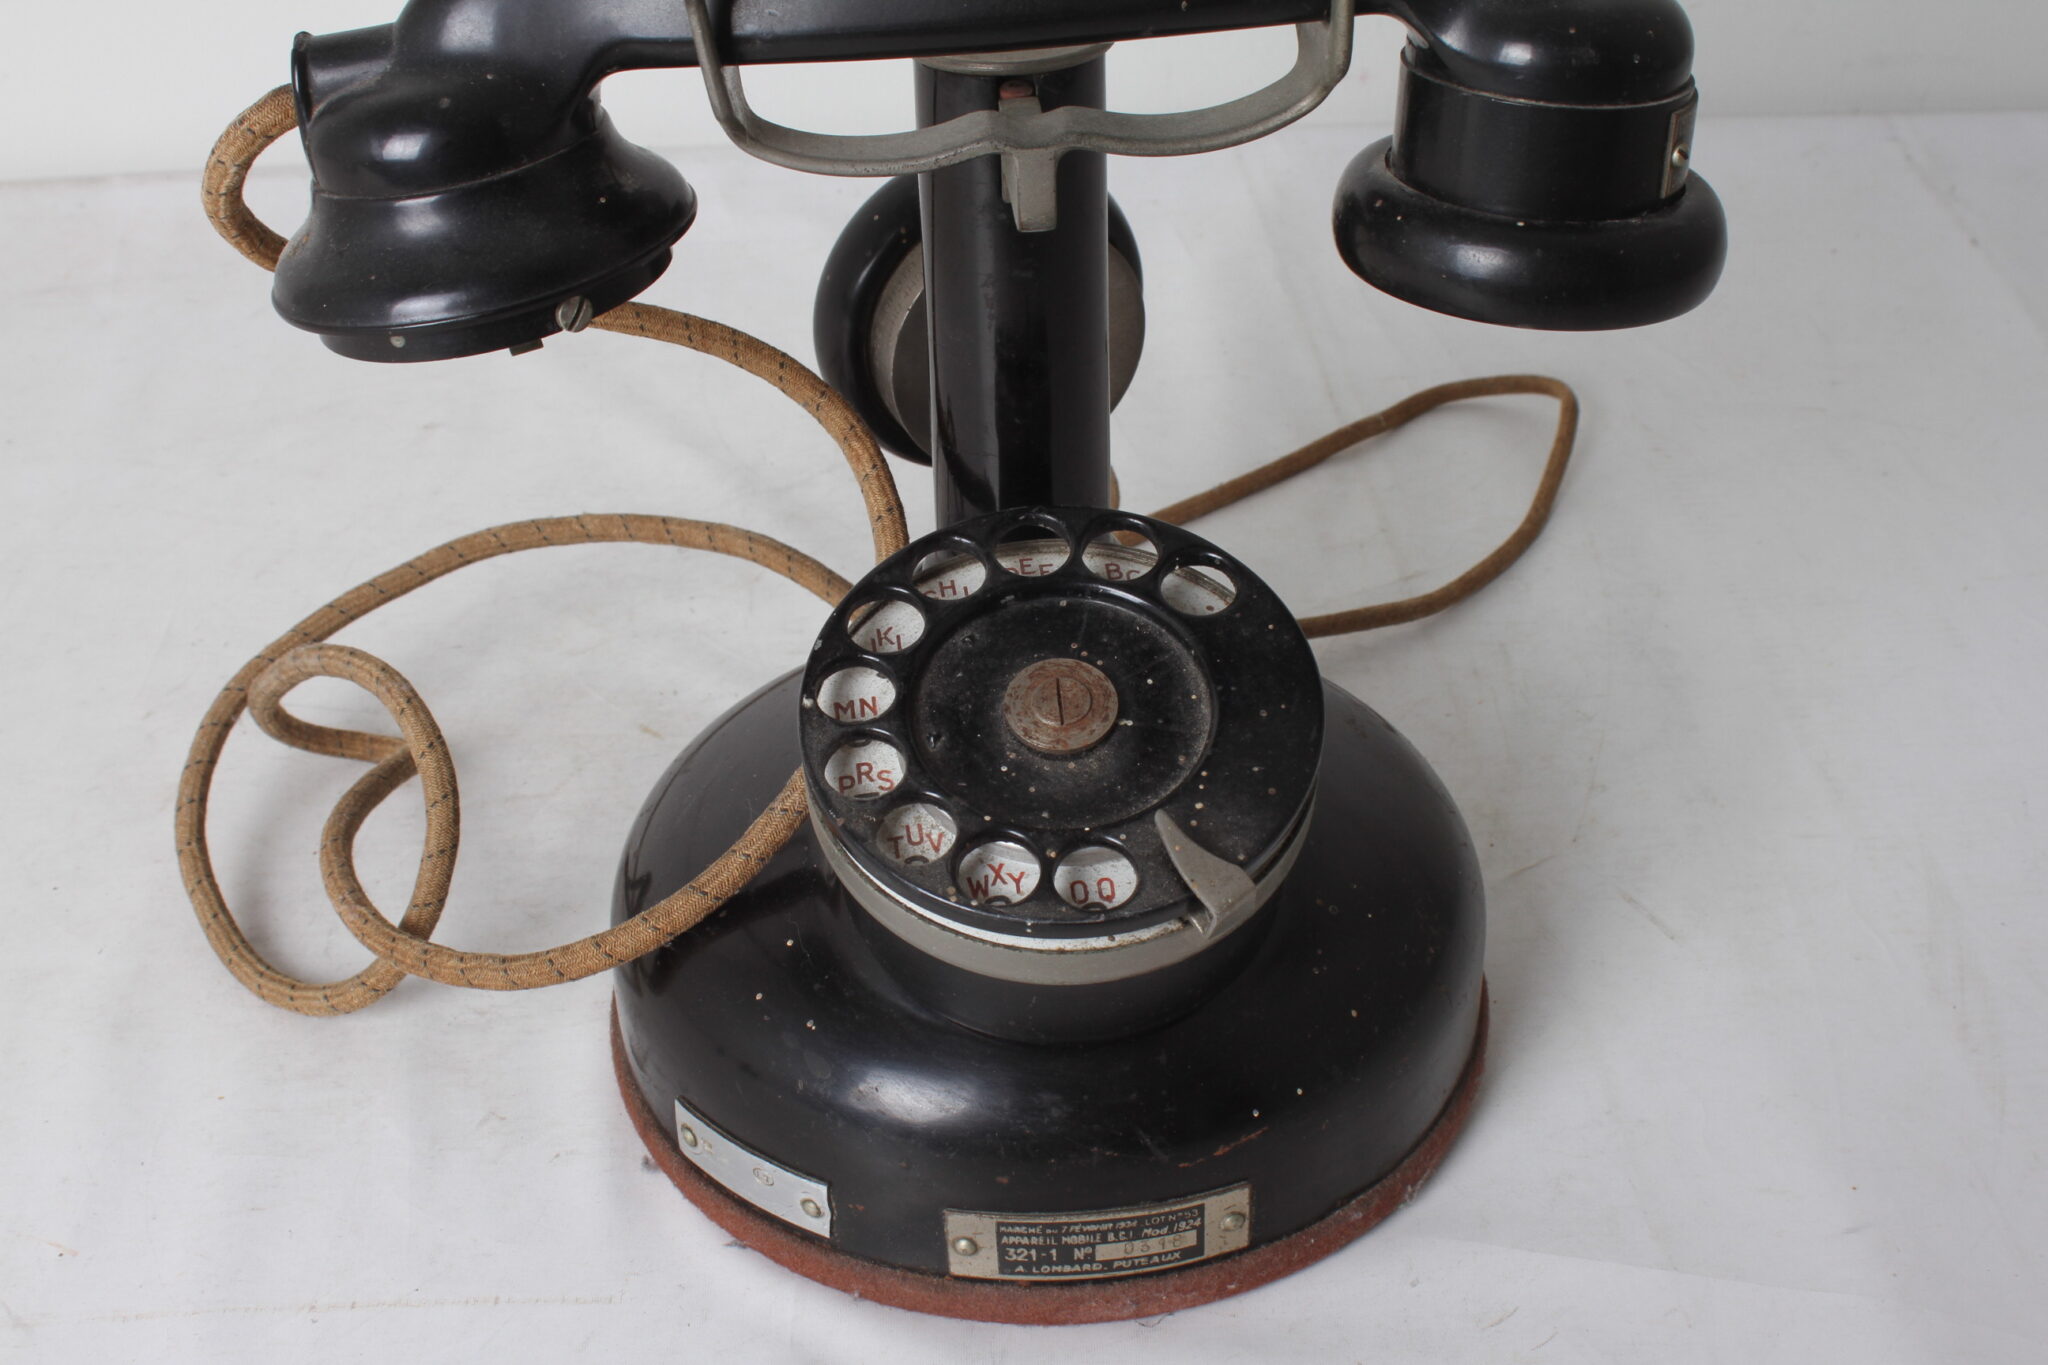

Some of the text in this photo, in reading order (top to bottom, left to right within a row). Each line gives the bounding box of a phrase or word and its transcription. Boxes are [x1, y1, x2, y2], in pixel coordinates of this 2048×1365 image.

[833, 696, 878, 720] MN
[838, 761, 896, 795] PRS
[887, 823, 944, 859] TUV
[966, 862, 1027, 899] WXY
[1145, 1215, 1165, 1226] LOT
[1001, 1235, 1059, 1246] APPAREIL
[1061, 1232, 1102, 1245] MOBILE
[1005, 1247, 1057, 1261] 321-1
[1112, 1250, 1182, 1270] PUTEAUX
